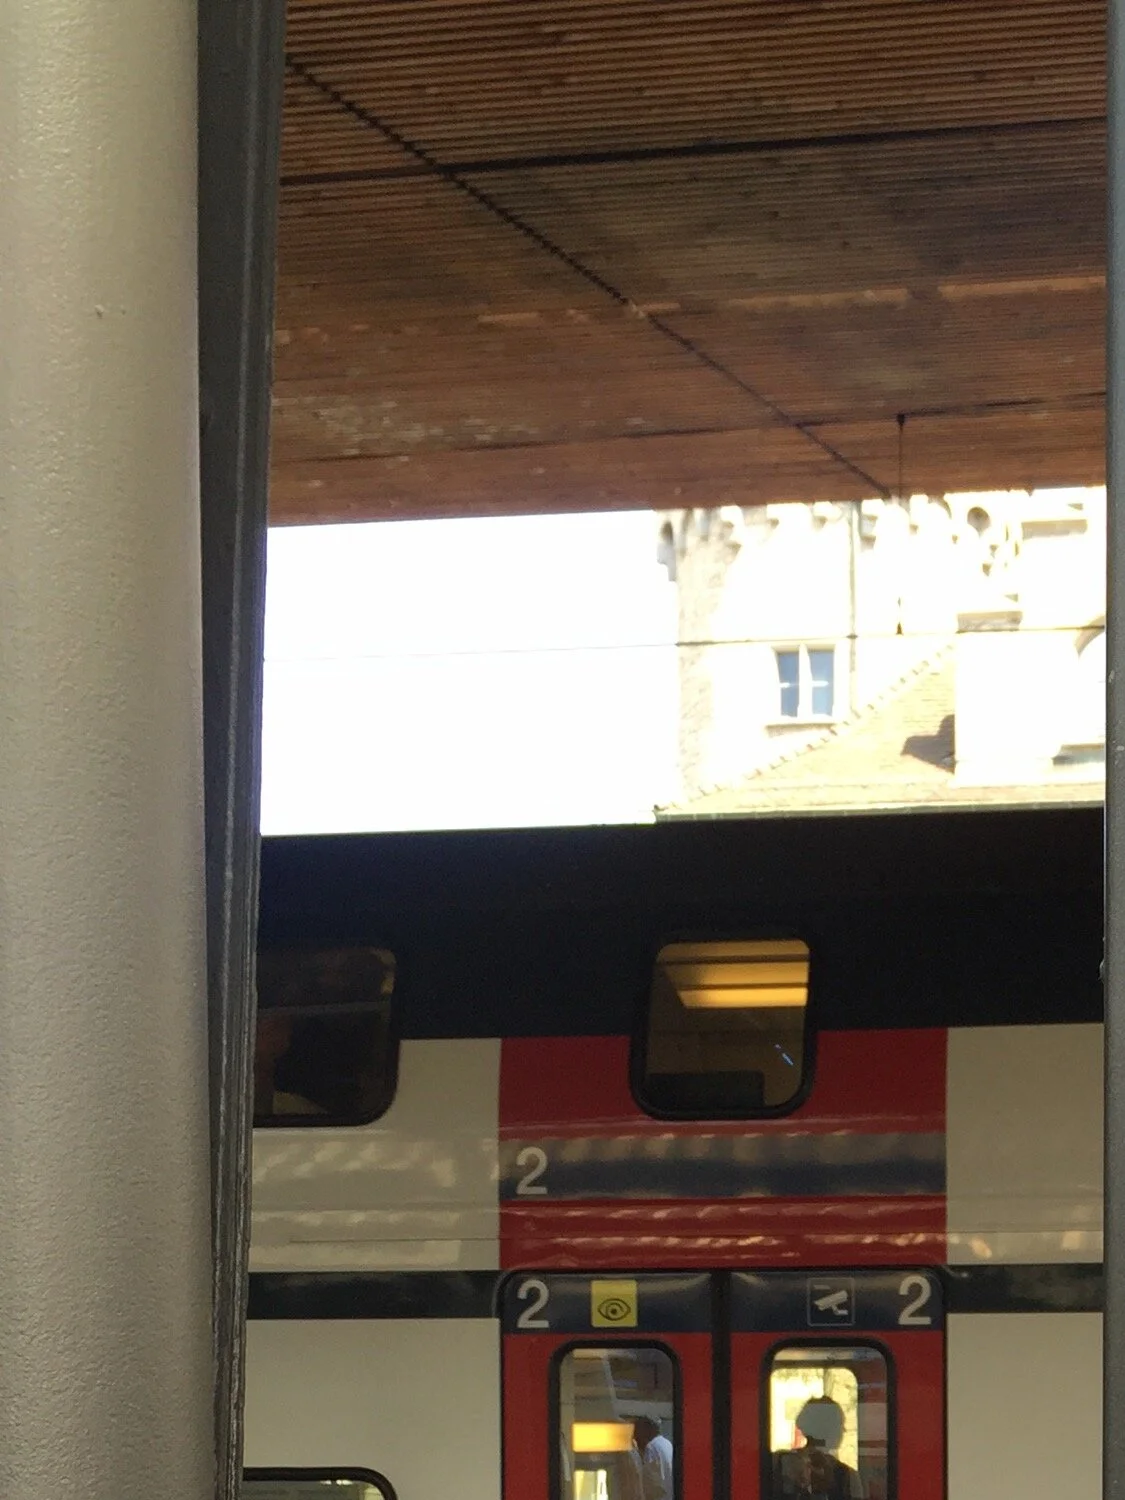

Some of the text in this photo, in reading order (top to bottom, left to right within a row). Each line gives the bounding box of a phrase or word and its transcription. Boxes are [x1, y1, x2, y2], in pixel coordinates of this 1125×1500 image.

[515, 1146, 549, 1196] 2
[516, 1279, 550, 1329] 2
[898, 1275, 932, 1326] 2
